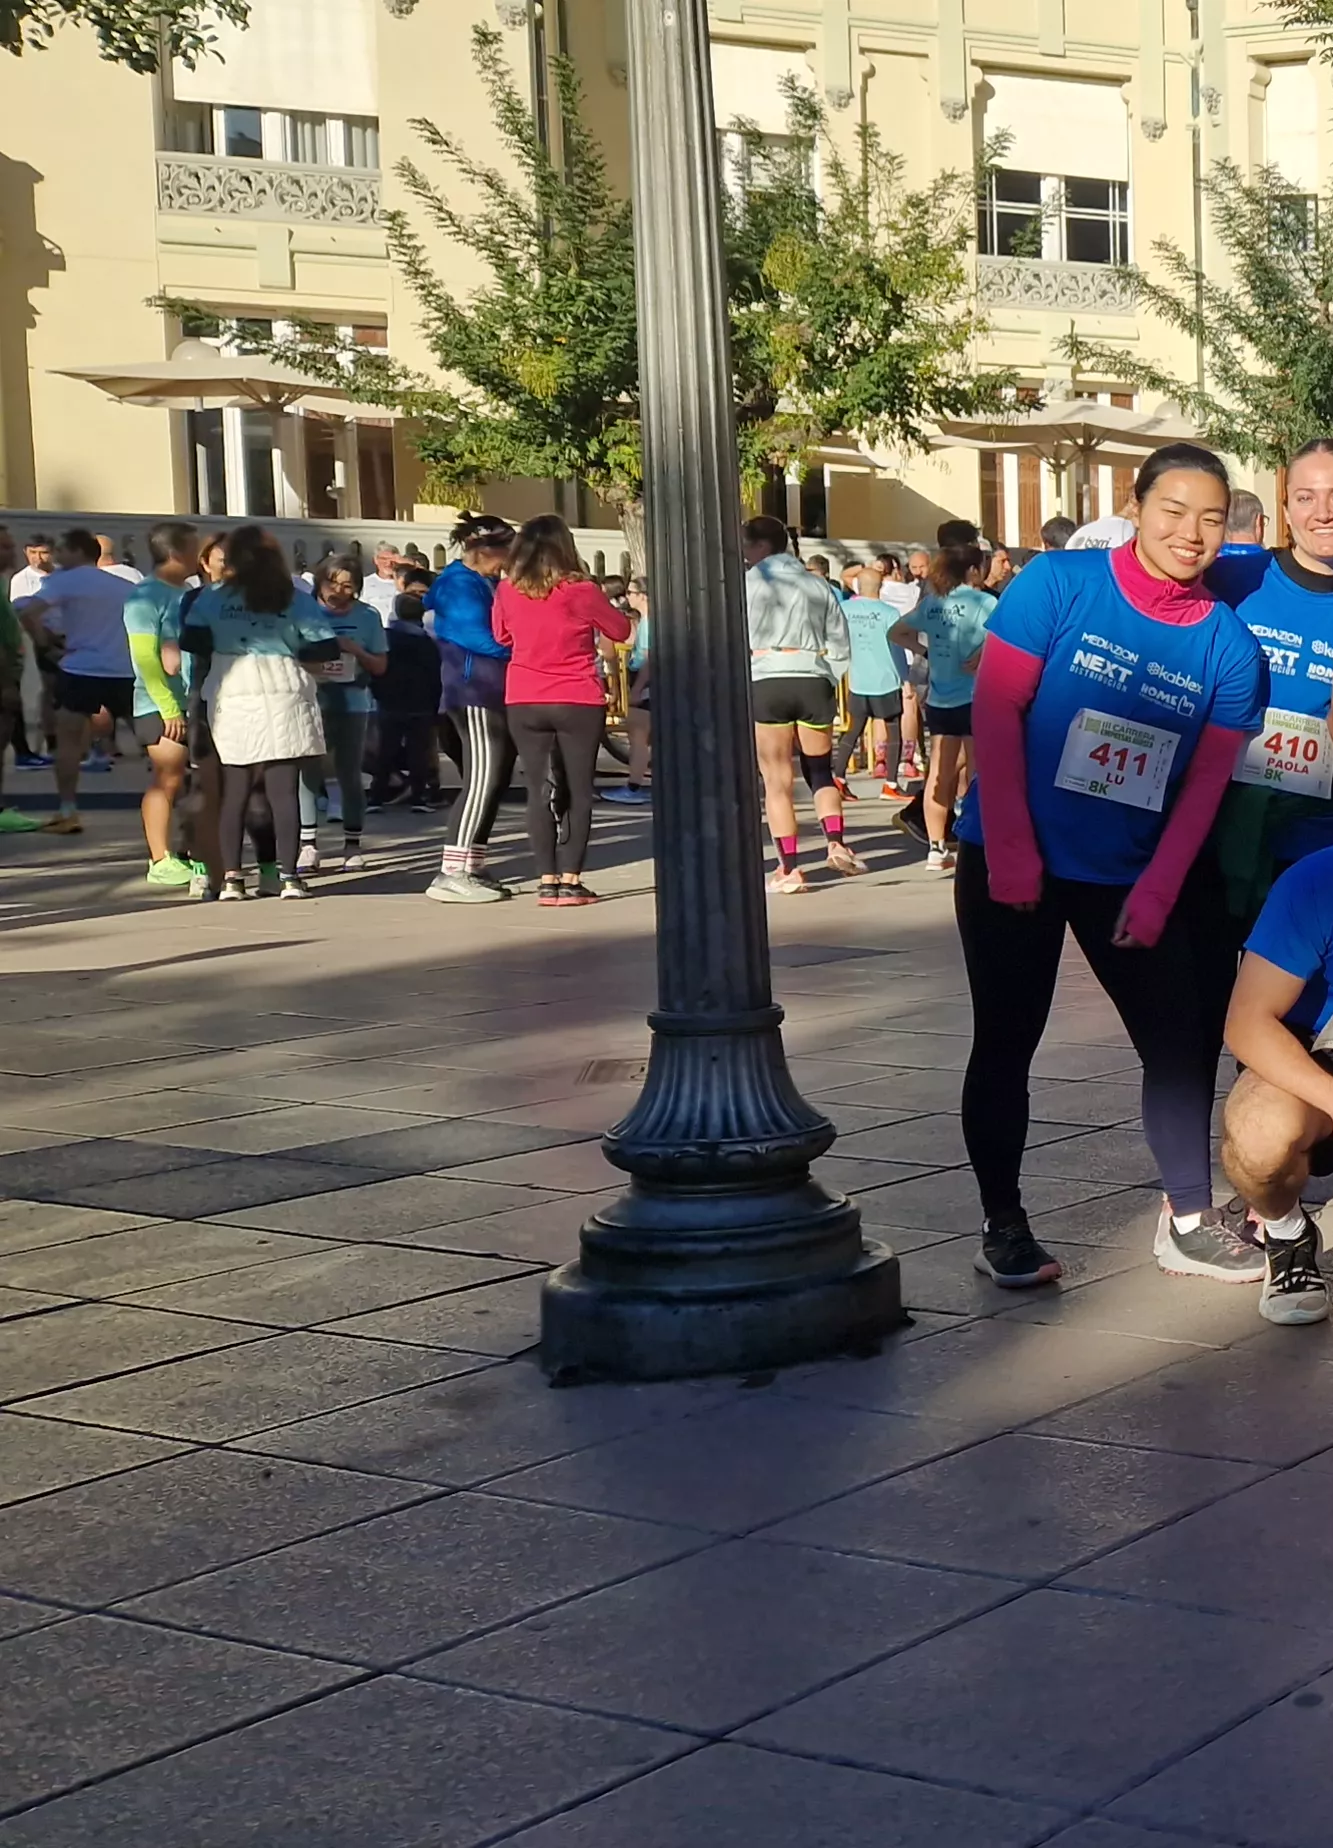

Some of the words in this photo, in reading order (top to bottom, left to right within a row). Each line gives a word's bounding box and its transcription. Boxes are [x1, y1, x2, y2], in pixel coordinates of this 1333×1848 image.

[1081, 632, 1139, 664] MEDIAZION
[1072, 649, 1133, 683] NEXT
[1159, 665, 1203, 695] kablex
[1140, 682, 1178, 706] HOME
[1088, 742, 1148, 776] 411
[1263, 732, 1318, 763] 410
[1105, 772, 1125, 786] LU
[1263, 768, 1285, 782] 8K
[1266, 757, 1309, 775] PAOLA
[1088, 780, 1110, 796] 8K
